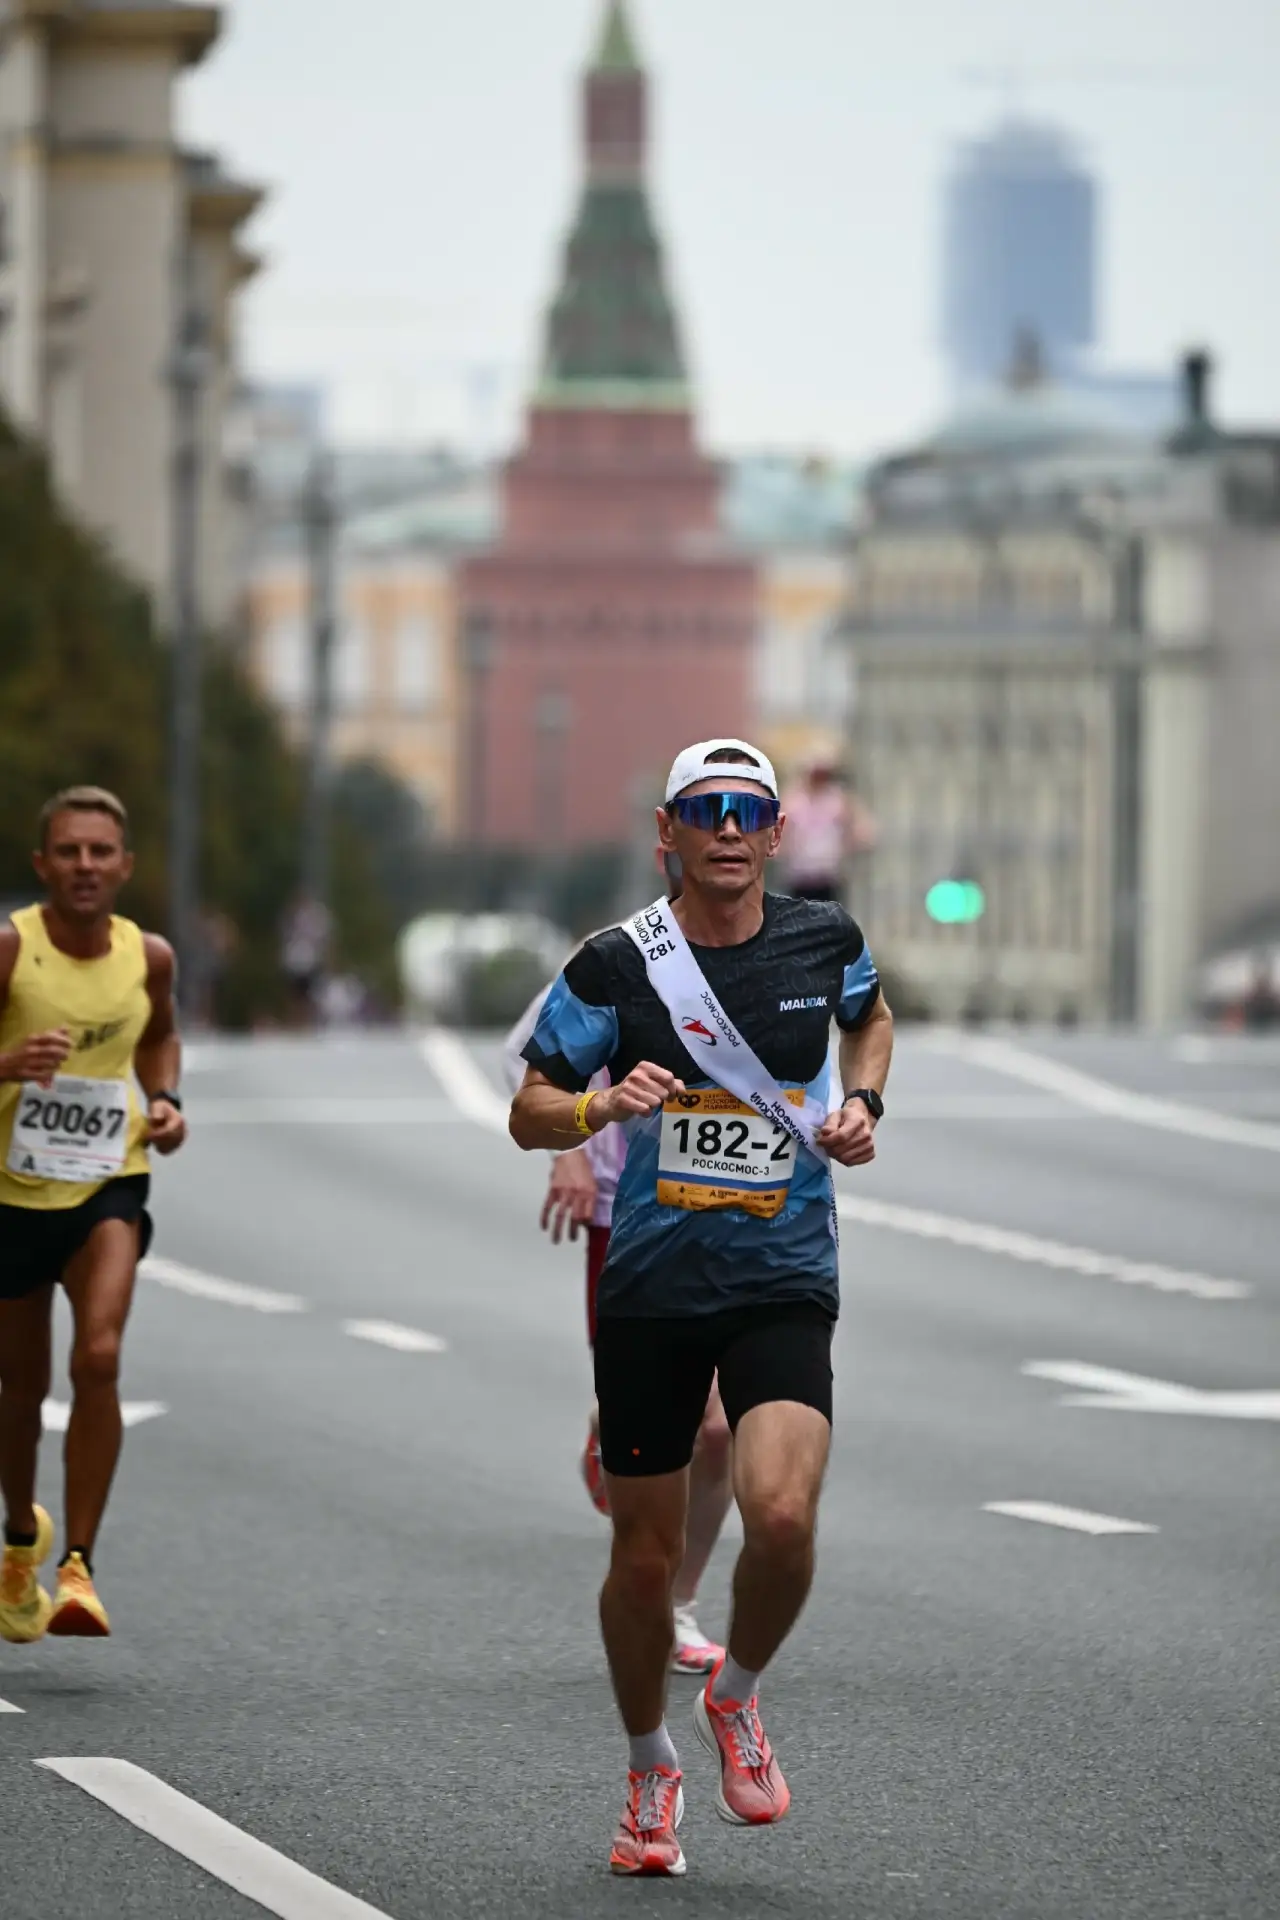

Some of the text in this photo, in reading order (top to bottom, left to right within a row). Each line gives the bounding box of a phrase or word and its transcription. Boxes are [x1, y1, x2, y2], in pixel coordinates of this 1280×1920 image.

[646, 939, 677, 961] 182
[700, 991, 741, 1048] РОСКОСМОС
[20, 1098, 125, 1140] 20067
[673, 1118, 791, 1162] 182-2
[691, 1158, 770, 1176] РОСКОСМОС-3
